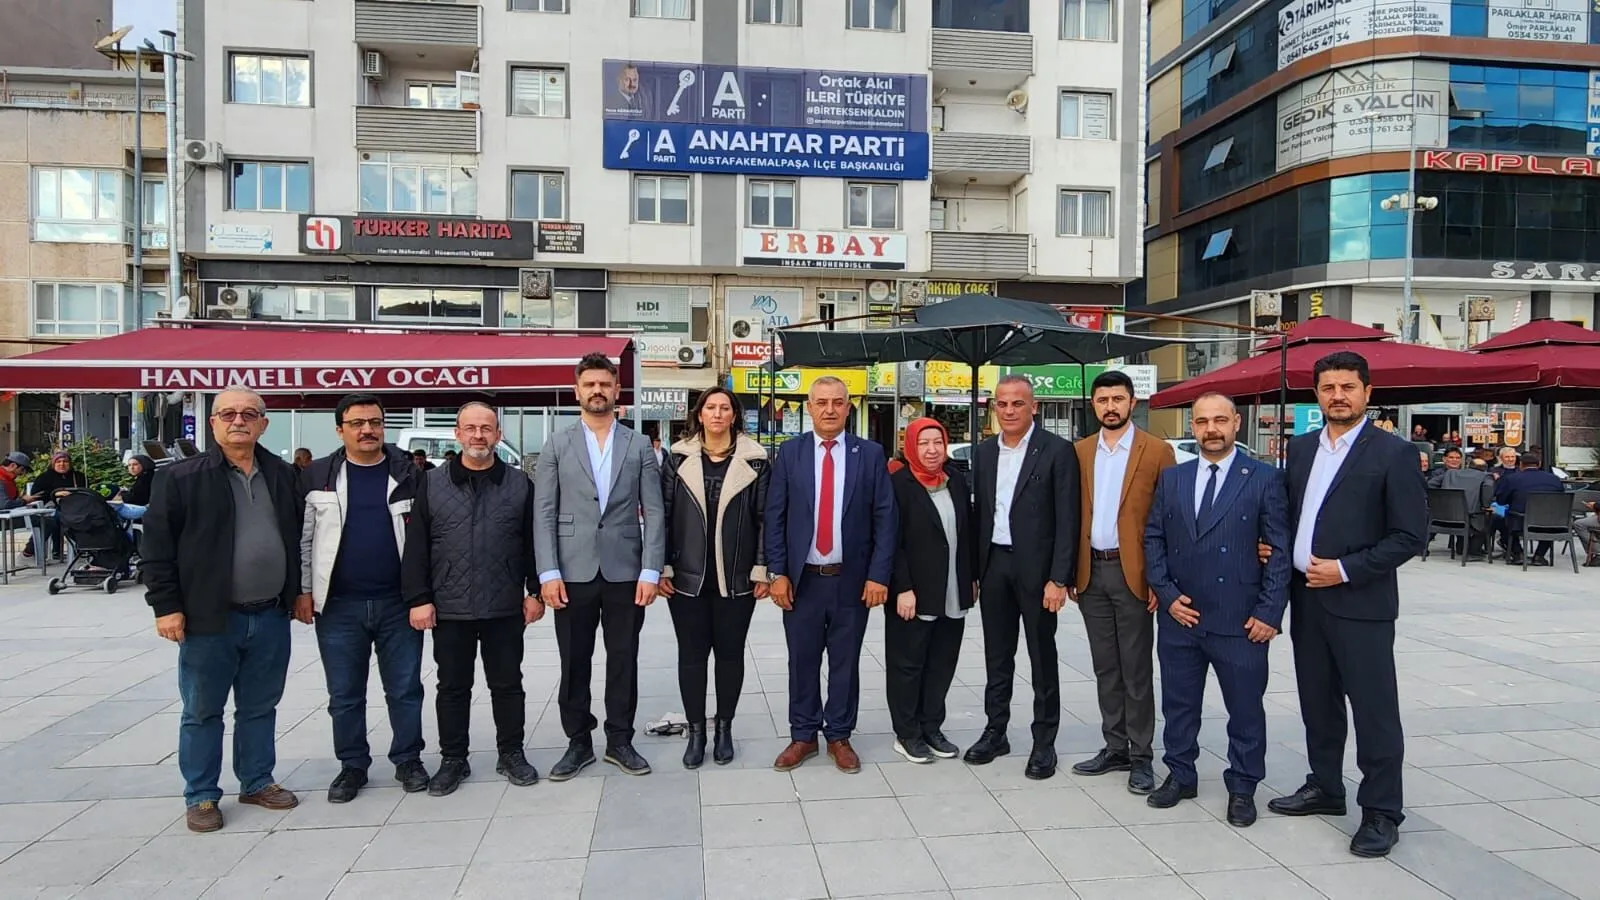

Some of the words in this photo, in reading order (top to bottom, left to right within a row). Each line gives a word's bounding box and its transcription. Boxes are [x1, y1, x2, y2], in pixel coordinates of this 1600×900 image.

[1295, 0, 1352, 24] TARIMS
[1491, 8, 1545, 19] PARLAKLAR
[1529, 24, 1576, 33] PARLAKLAR
[711, 72, 746, 107] A
[819, 75, 862, 88] Ortak
[865, 77, 893, 89] Akıl
[806, 88, 841, 103] İLERİ
[845, 91, 906, 106] TÜRKİYE
[1342, 103, 1353, 114] &
[653, 129, 677, 154] A
[688, 130, 823, 154] ANAHTAR
[689, 156, 810, 169] MUSTAFAKEMALPAŞA
[813, 158, 837, 170] İLÇE
[840, 160, 904, 172] BAŞKANLIĞI
[1423, 150, 1600, 177] KAPLA
[352, 218, 430, 237] TÜRKER
[759, 232, 891, 257] ERBAY
[636, 301, 659, 311] HDI
[316, 368, 376, 388] ÇAY
[387, 366, 490, 387] OCAĞI
